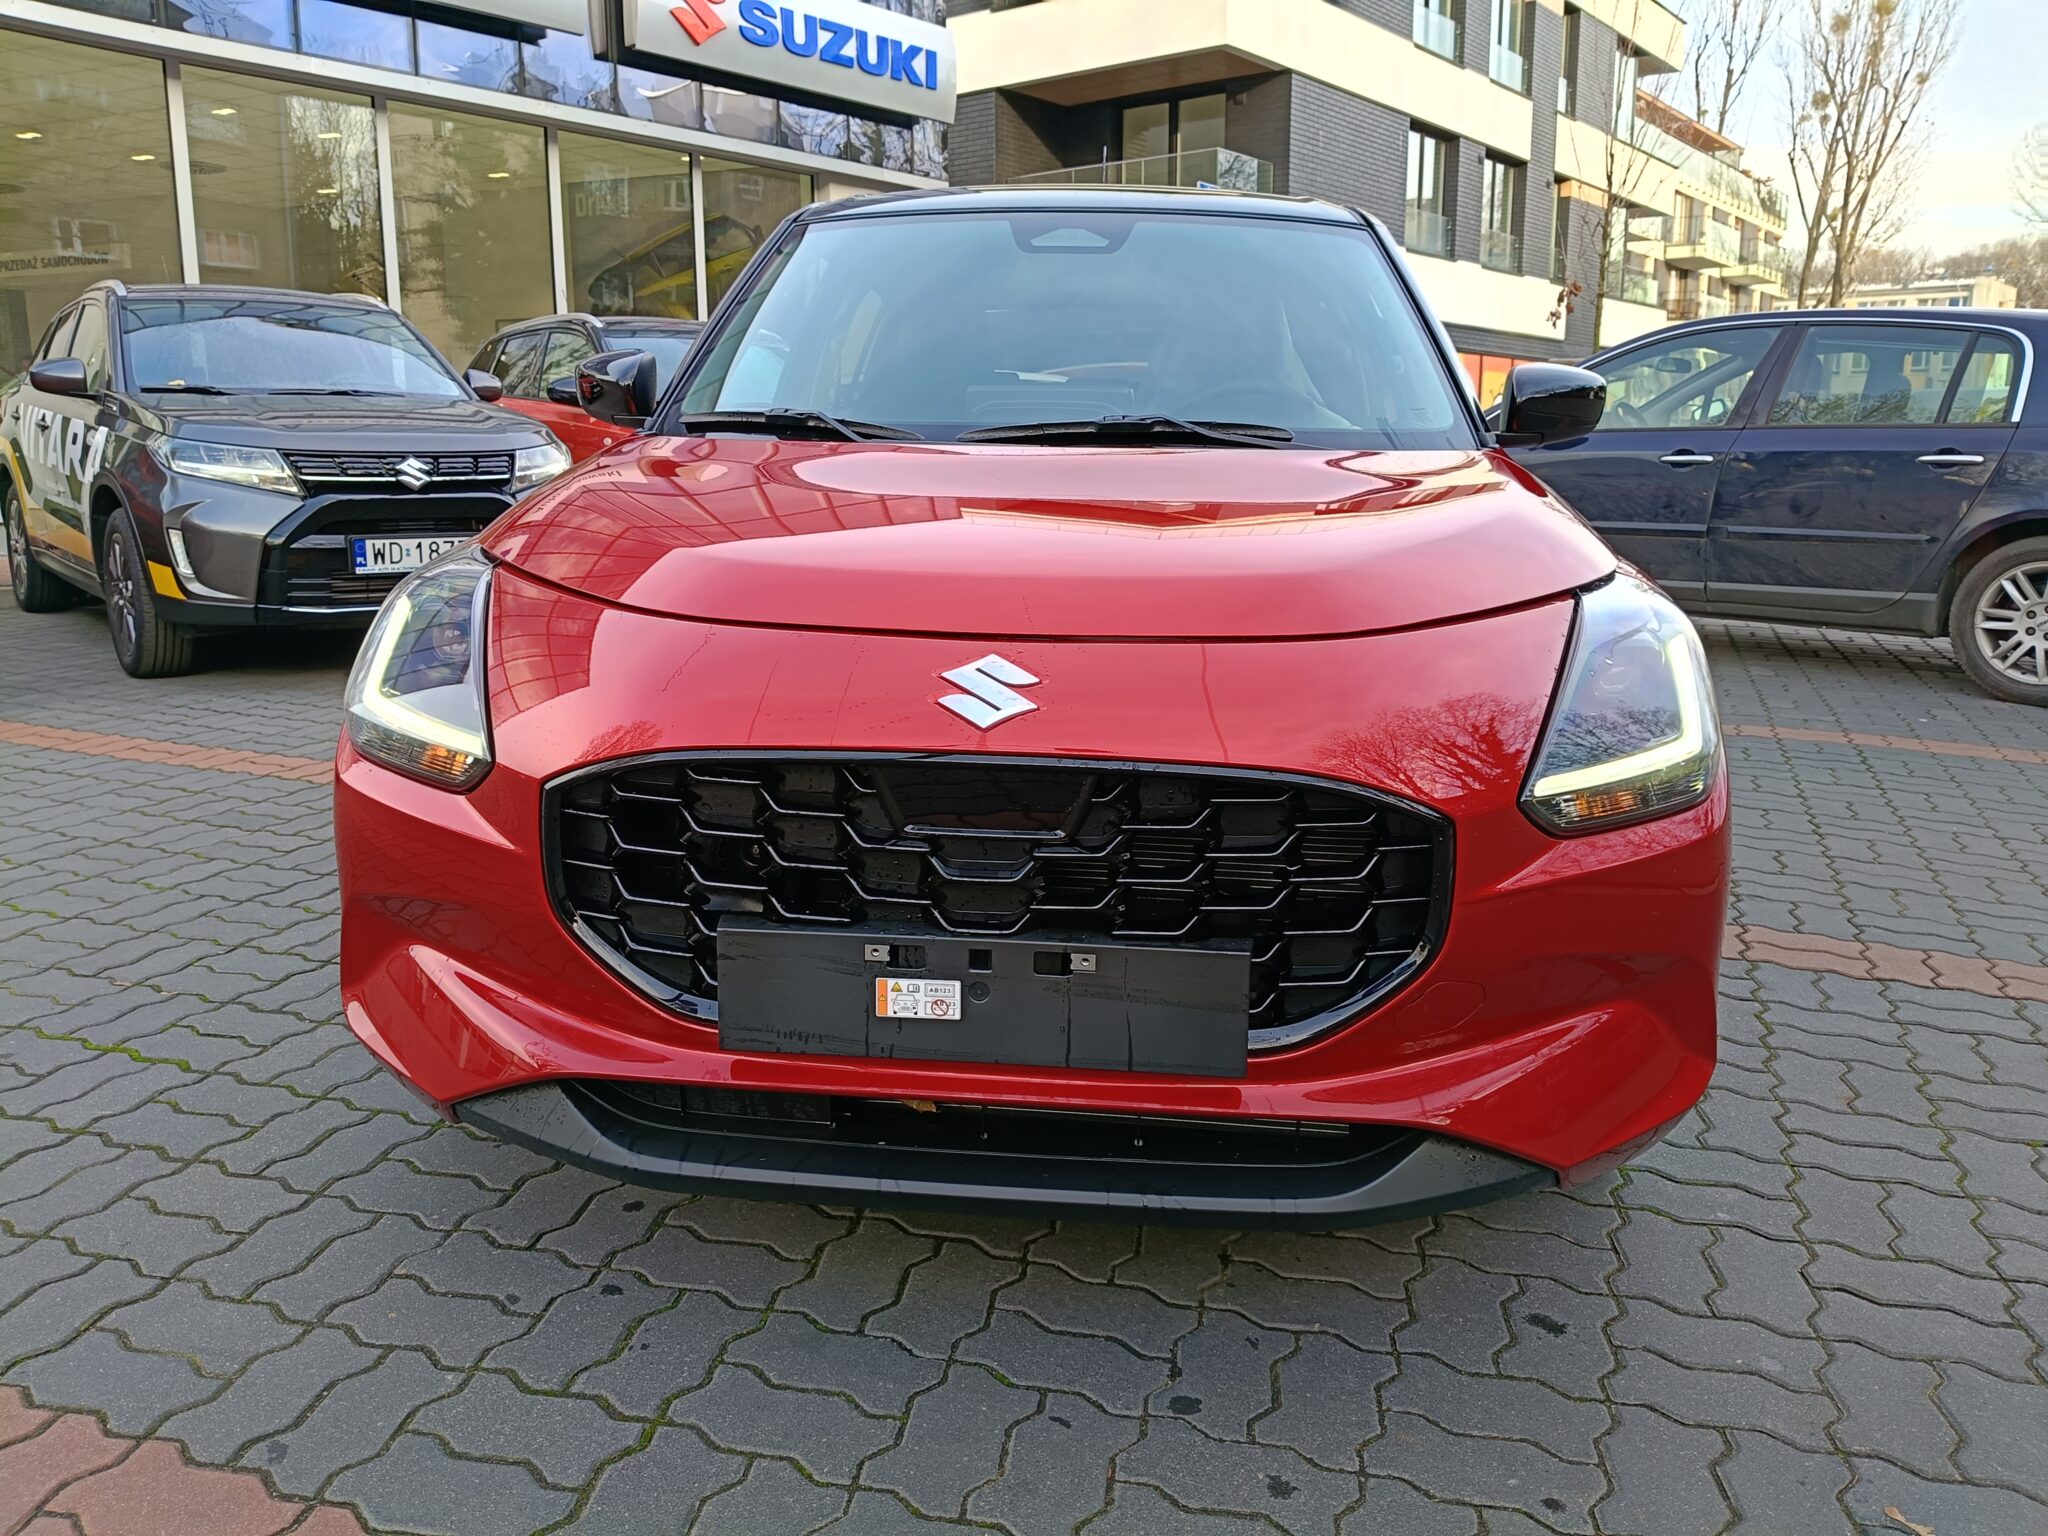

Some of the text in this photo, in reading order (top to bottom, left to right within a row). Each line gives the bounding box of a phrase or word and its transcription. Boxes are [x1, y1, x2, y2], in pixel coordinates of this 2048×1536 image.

[739, 0, 938, 91] SUZUKI
[20, 402, 109, 484] VITARA
[371, 540, 465, 565] WD 187
